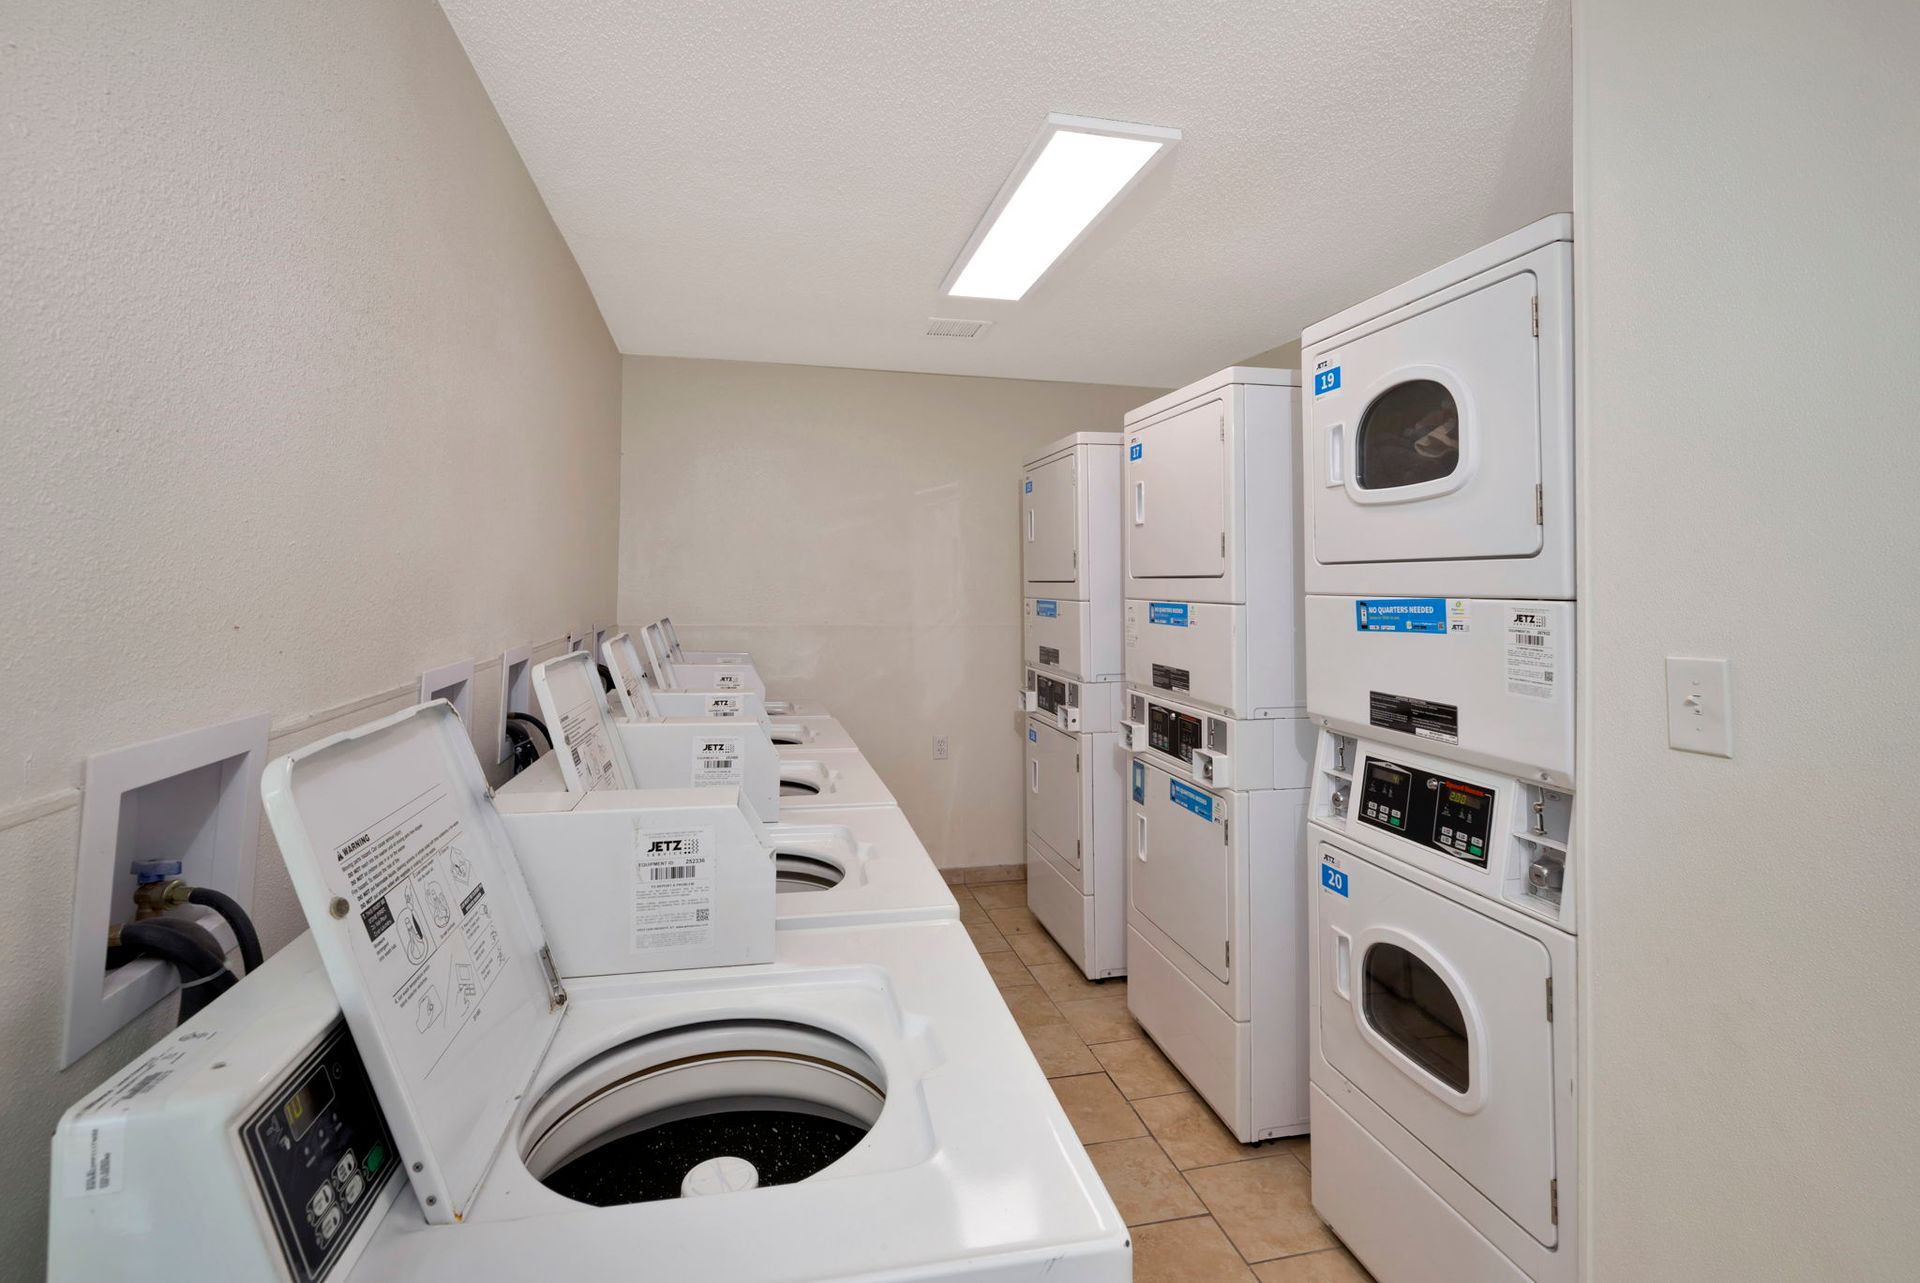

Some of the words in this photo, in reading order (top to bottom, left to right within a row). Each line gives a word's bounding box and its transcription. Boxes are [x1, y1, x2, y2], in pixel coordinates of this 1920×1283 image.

[1321, 372, 1335, 390] 19
[1378, 606, 1409, 615] QUARTERS
[1409, 606, 1434, 614] NEEDED
[1513, 614, 1536, 623] JETZ
[702, 743, 725, 751] JETZ
[342, 834, 370, 856] WARNING
[647, 840, 682, 852] JETZ
[638, 860, 668, 868] EQUIPMENT
[1328, 870, 1342, 889] 20
